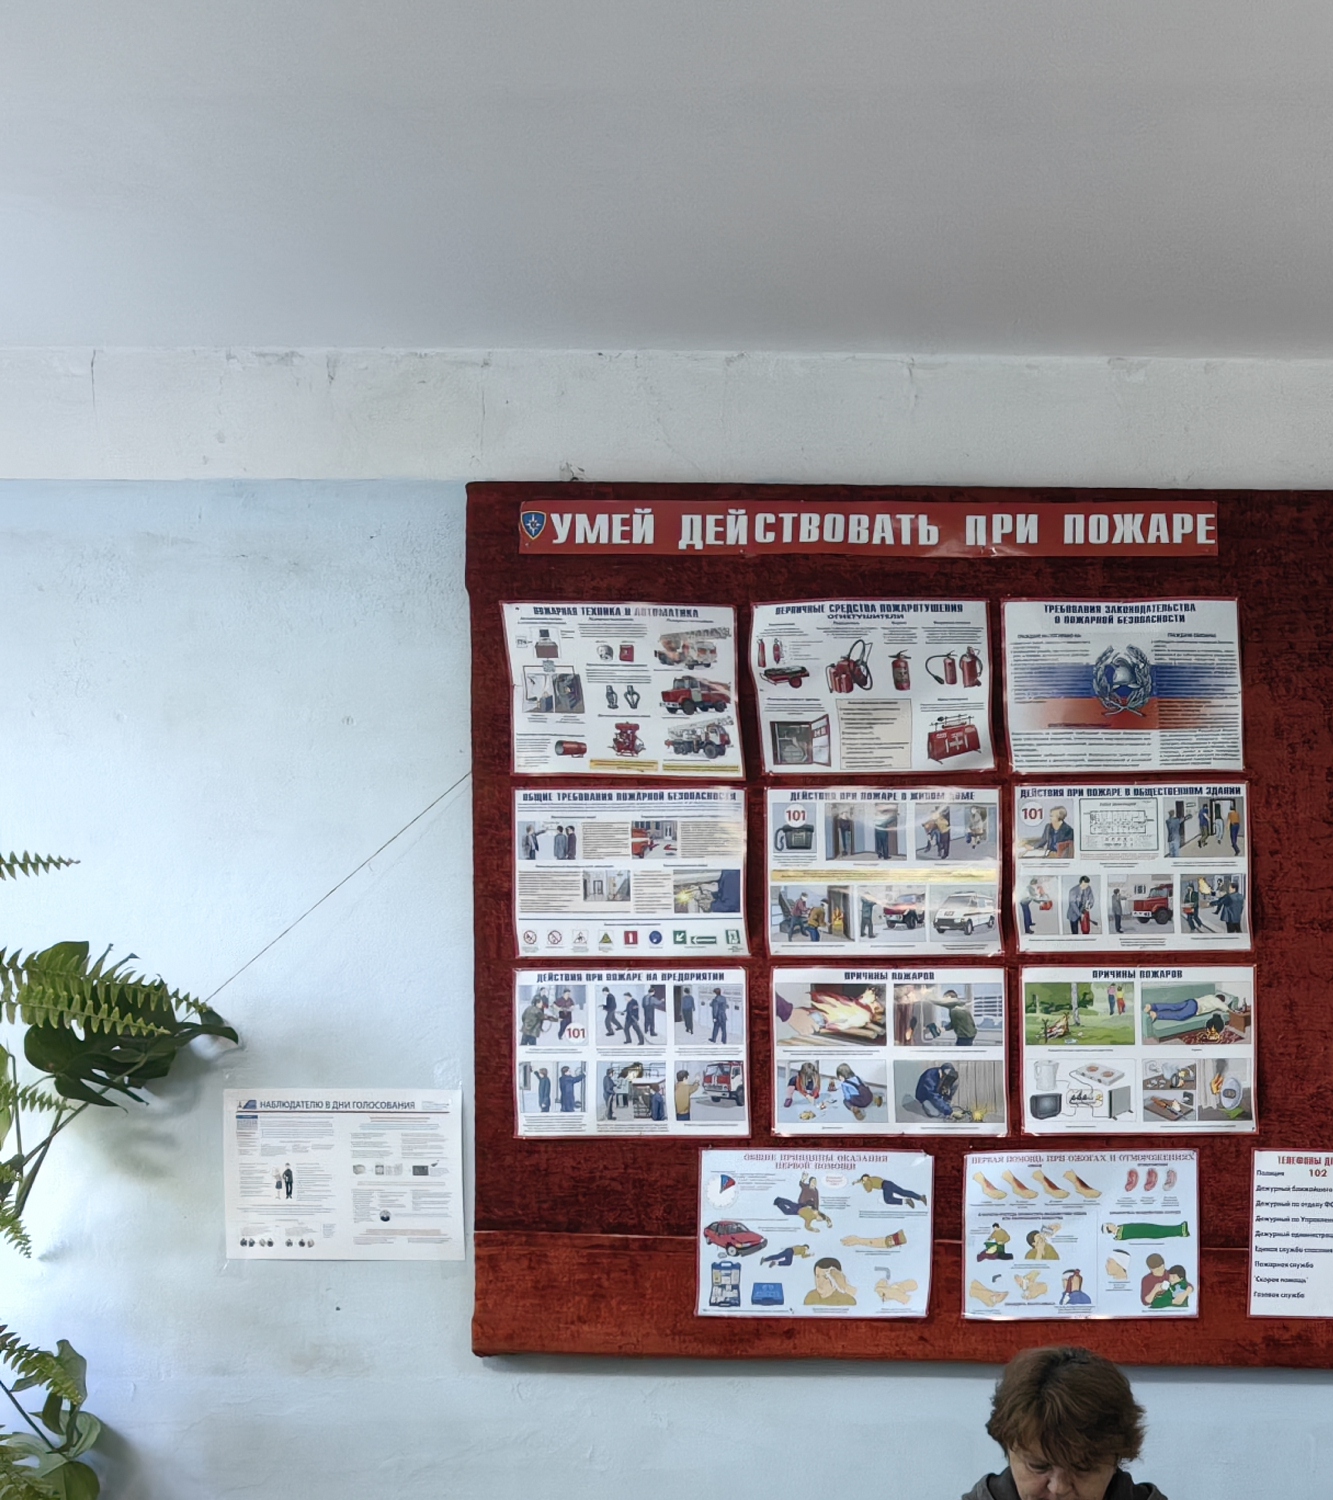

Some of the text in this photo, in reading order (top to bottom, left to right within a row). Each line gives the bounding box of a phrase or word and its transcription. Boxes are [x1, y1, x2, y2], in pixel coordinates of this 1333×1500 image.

[551, 508, 1215, 549] УМЕЙ ДЕЙСТВОВАТЬ ПРИ ПОЖАРЕ
[581, 607, 621, 616] ТЕХНИКА
[829, 604, 877, 614] СРЕДСТВА
[880, 603, 963, 613] ПОЖАРОТУШЕНИЯ
[1044, 603, 1196, 615] ТРЕБОВАНИЯ ЗАКОНОДАТЕЛЬСТВА
[1064, 614, 1113, 624] ПОЖАРНОЙ
[1117, 614, 1185, 625] БЕЗОПАСНОСТИ
[523, 792, 552, 802] ОБЩИЕ
[557, 792, 613, 801] ТРЕБОВАНИЯ
[616, 791, 664, 801] ПОЖАРНОЙ
[861, 791, 897, 800] ПОЖАРЕ
[1067, 788, 1084, 797] ПРИ
[1087, 788, 1122, 797] ПОЖАРЕ
[1134, 787, 1203, 798] ОБЩЕСТВЕННОМ
[1206, 786, 1241, 796] ЗДАНИИ
[786, 810, 807, 821] 101
[1022, 808, 1043, 820] 101
[537, 972, 725, 982] ДЕЙСТВИЯ ПРИ ПОЖАРЕ НА ПРЕДПРИЯТИИ
[844, 971, 935, 980] ПРИЧИНЫ ПОЖАРОВ
[1092, 970, 1183, 979] ПРИЧИНЫ ПОЖАРОВ
[566, 1026, 586, 1039] 101
[260, 1101, 415, 1110] НАБЛЮДАТЕЛЮ В ДНИ ГОЛОСОВАНИЯ
[1278, 1156, 1321, 1165] ТЕЛЕФОНЫ
[1309, 1169, 1327, 1177] 102
